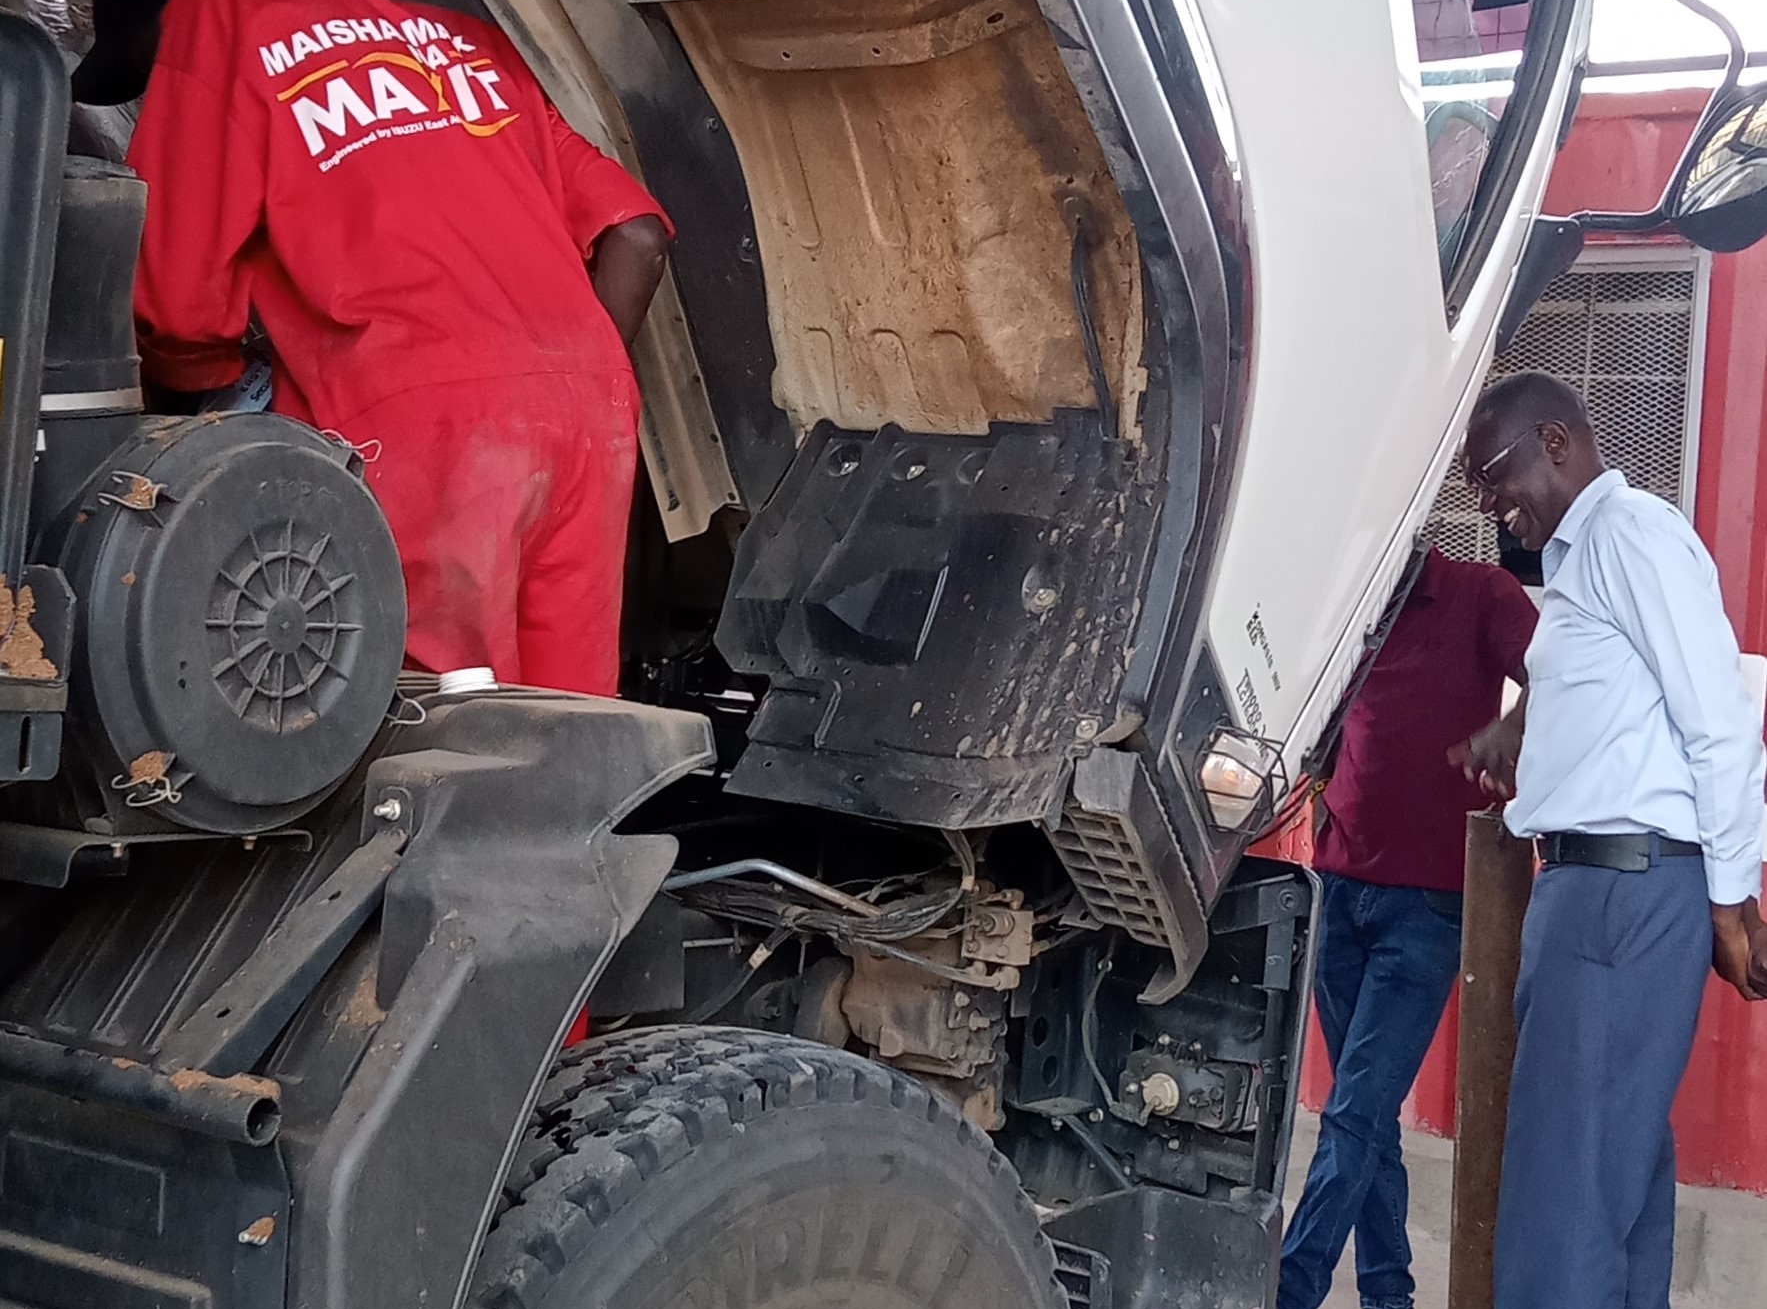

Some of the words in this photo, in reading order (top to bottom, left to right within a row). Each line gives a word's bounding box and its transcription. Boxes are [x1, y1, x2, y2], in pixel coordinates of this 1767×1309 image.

[259, 18, 405, 76] MAISHA
[318, 132, 377, 173] Engineered
[376, 127, 391, 139] by
[392, 122, 424, 135] ISUZU
[424, 117, 449, 130] East
